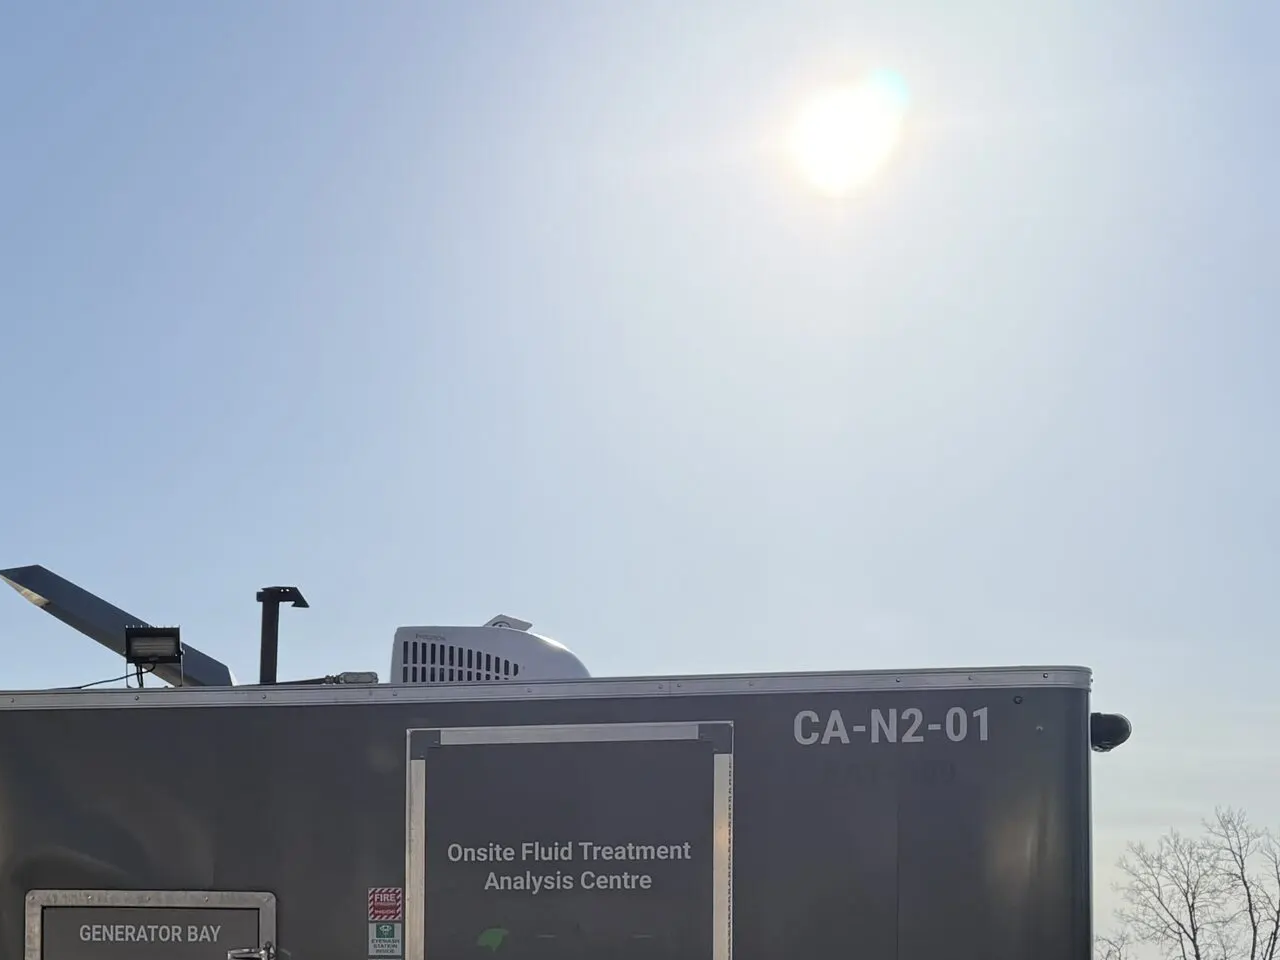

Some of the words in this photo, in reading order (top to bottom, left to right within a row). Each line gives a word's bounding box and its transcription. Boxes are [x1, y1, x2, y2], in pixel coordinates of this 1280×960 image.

[793, 706, 989, 745] CA-N2-01
[447, 842, 516, 862] Onsite
[521, 841, 573, 861] Fluid
[578, 841, 692, 861] Treatment
[483, 870, 574, 895] Analysis
[580, 870, 653, 890] Centre
[374, 893, 396, 902] FIRE
[79, 924, 183, 943] GENERATOR
[187, 924, 222, 943] BAY
